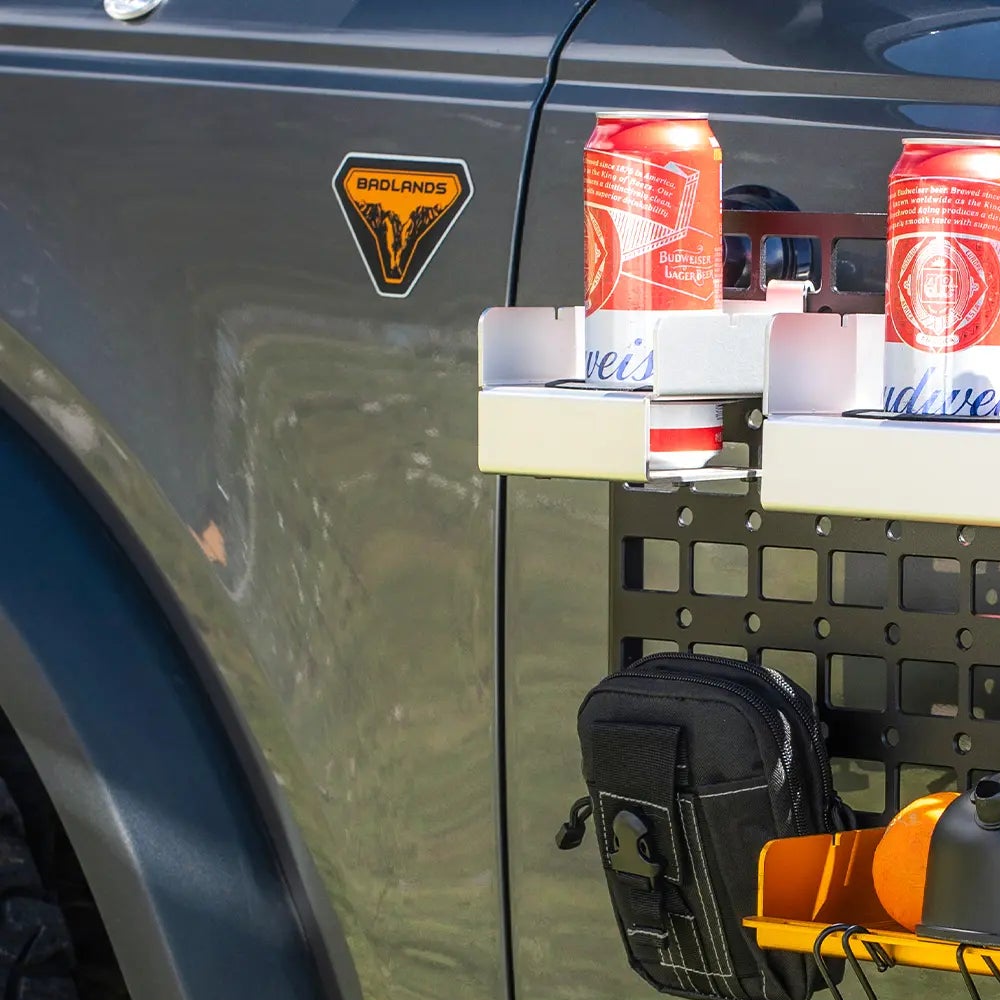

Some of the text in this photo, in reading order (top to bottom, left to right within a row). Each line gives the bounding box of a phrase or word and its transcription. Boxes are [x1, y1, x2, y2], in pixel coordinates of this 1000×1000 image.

[357, 178, 447, 194] BADLANDS
[601, 171, 617, 181] King
[619, 175, 629, 183] of
[657, 187, 674, 198] Our
[644, 172, 676, 189] America,
[595, 190, 623, 202] superior
[911, 195, 952, 204] worldwide
[955, 198, 965, 206] as
[967, 198, 982, 207] the
[951, 187, 981, 197] Brewed
[982, 192, 1000, 201] since
[649, 195, 672, 209] clean,
[918, 205, 941, 215] Aging
[942, 207, 980, 218] produces
[905, 216, 930, 225] smooth
[932, 217, 952, 225] taste
[954, 219, 972, 227] with
[659, 250, 711, 265] BUDWEISER
[965, 249, 982, 271] EUROPE
[665, 265, 714, 281] LAGER BEER
[965, 300, 982, 322] ASIA
